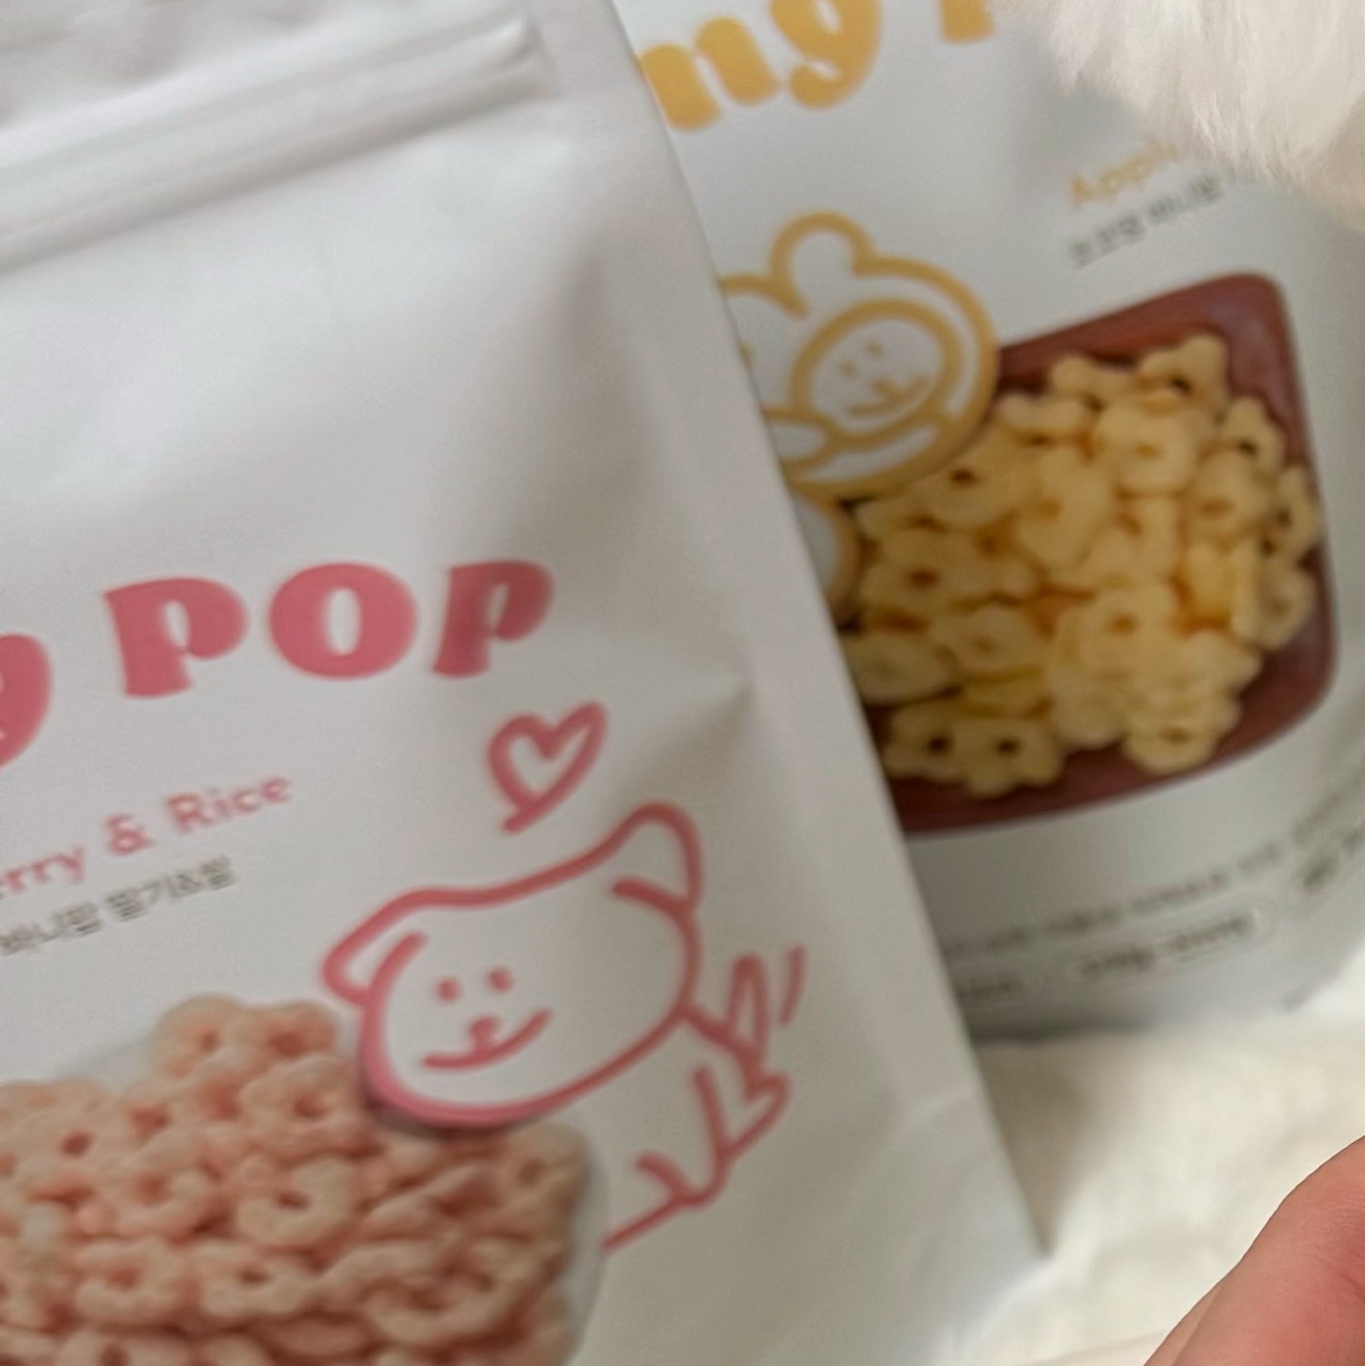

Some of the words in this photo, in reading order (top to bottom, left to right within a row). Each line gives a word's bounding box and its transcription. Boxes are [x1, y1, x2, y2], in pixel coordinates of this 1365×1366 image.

[0, 845, 86, 901] rry
[104, 812, 154, 857] &
[166, 777, 292, 834] Rice
